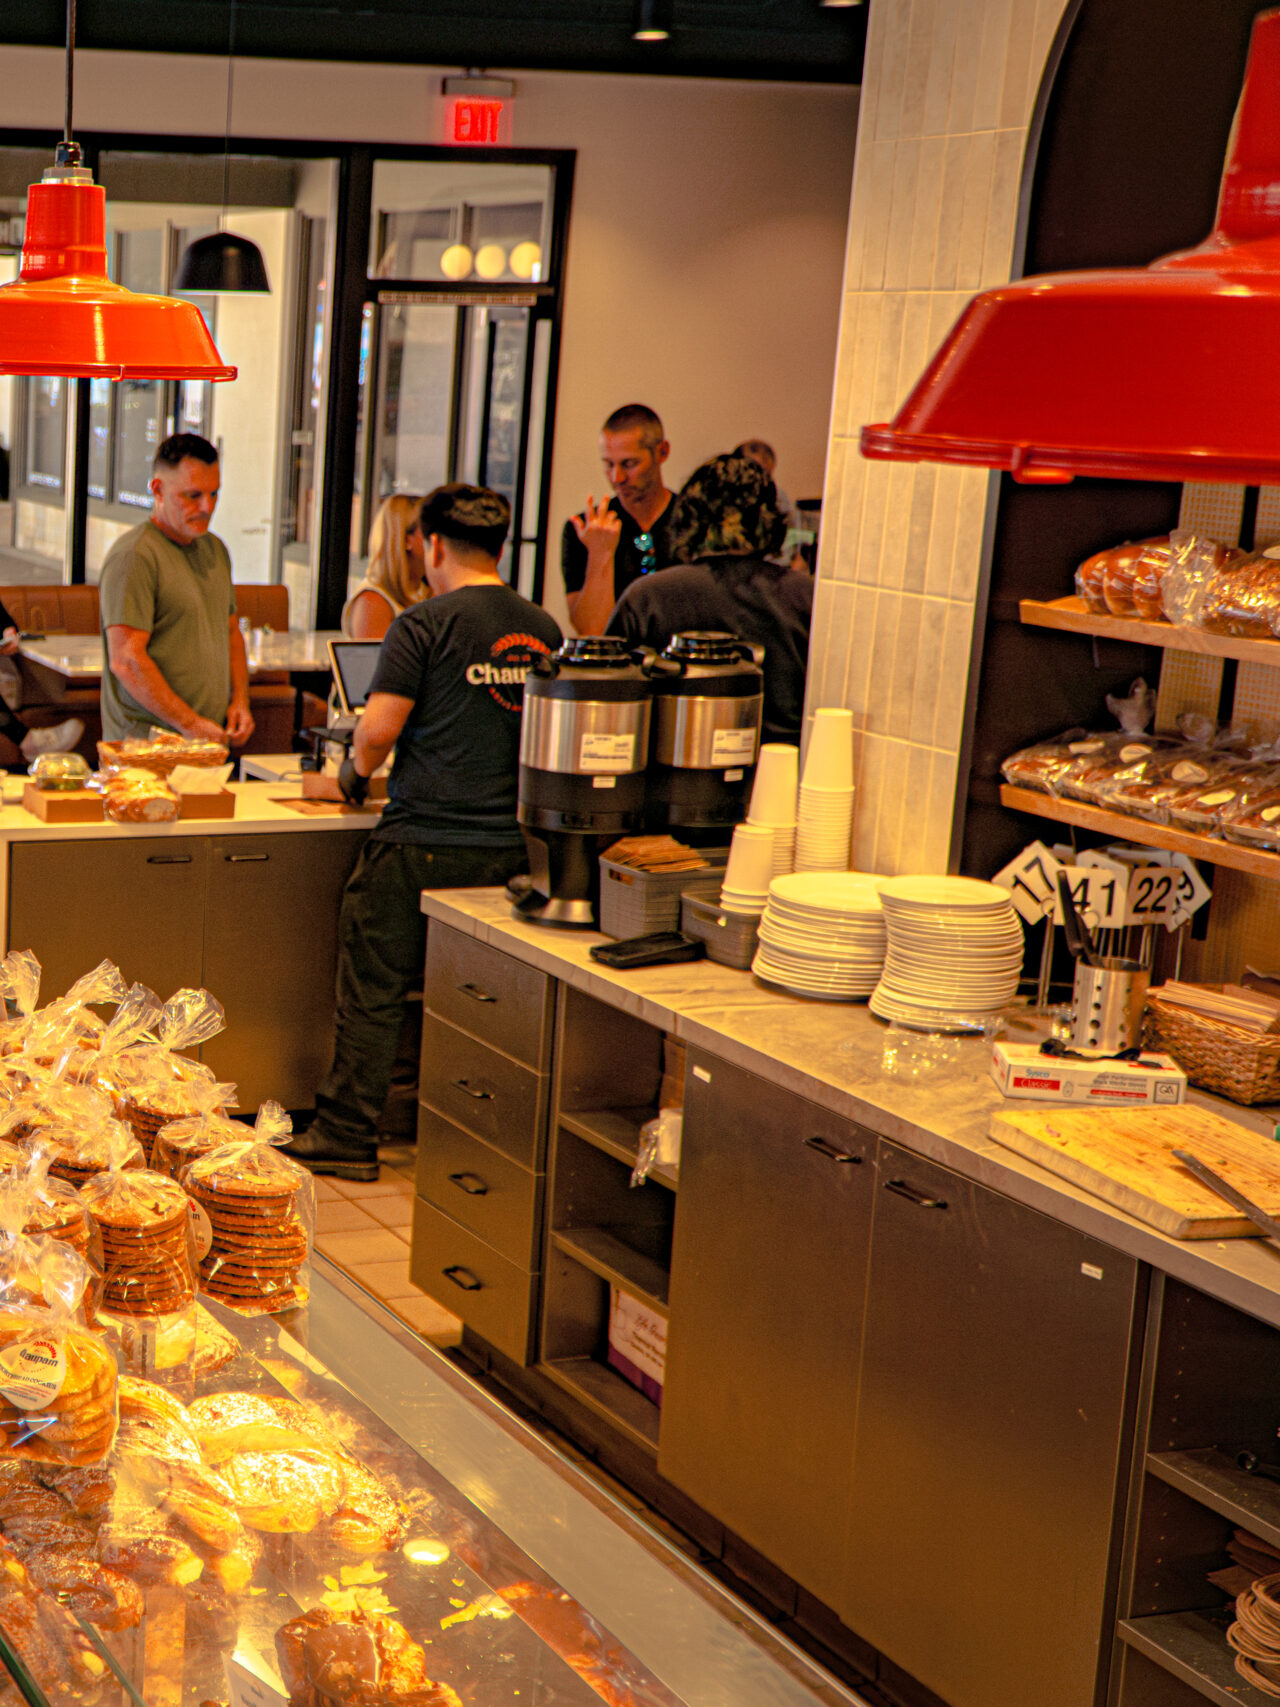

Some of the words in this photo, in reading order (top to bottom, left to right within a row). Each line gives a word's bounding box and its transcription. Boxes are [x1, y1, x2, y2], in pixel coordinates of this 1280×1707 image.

[454, 101, 503, 143] EXIT
[465, 662, 532, 686] Chau
[1012, 856, 1055, 904] 17
[1132, 876, 1172, 914] 22
[1174, 870, 1195, 910] 9
